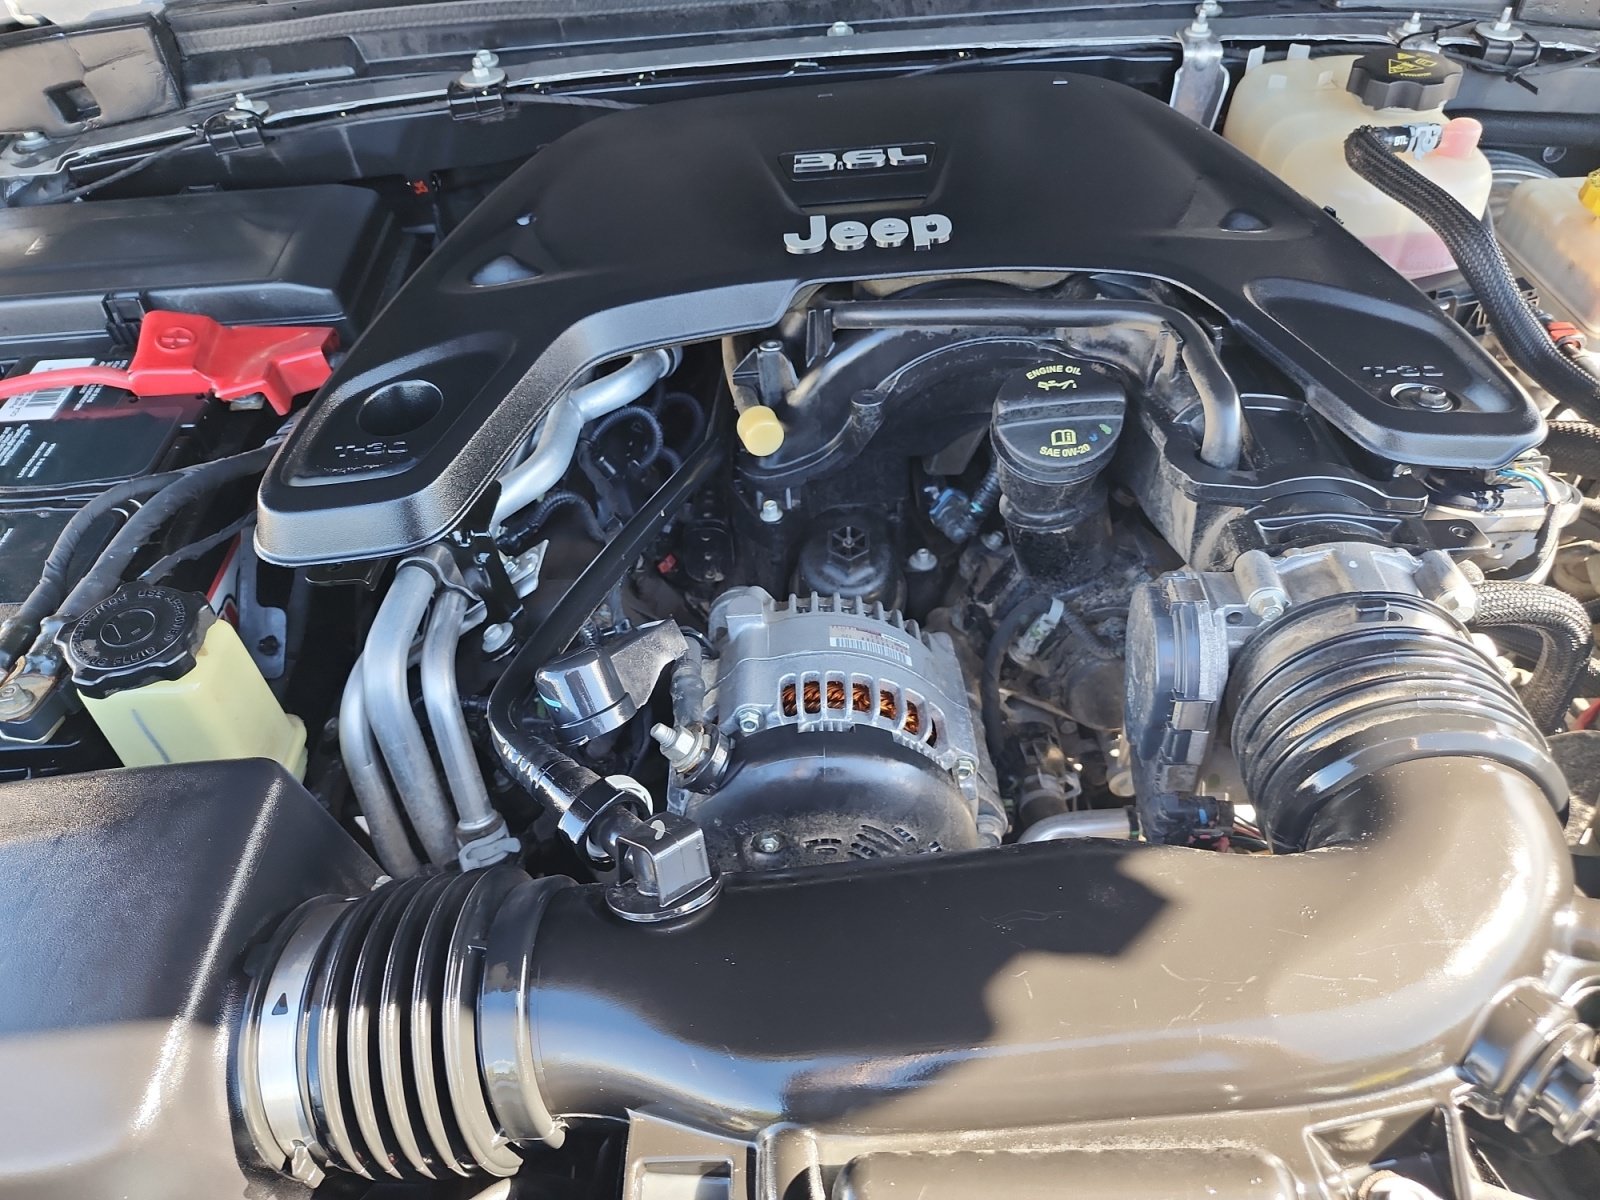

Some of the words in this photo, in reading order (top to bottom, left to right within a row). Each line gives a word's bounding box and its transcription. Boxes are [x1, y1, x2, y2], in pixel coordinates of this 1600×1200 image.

[793, 147, 928, 173] 3.6L
[783, 213, 953, 254] Jeep
[1025, 365, 1063, 380] ENGINE
[1064, 365, 1082, 376] OIL
[1039, 446, 1061, 457] SAE
[1062, 443, 1091, 457] 0W-20
[137, 589, 166, 599] USE
[80, 593, 128, 627] POWER
[112, 646, 157, 667] FLUID
